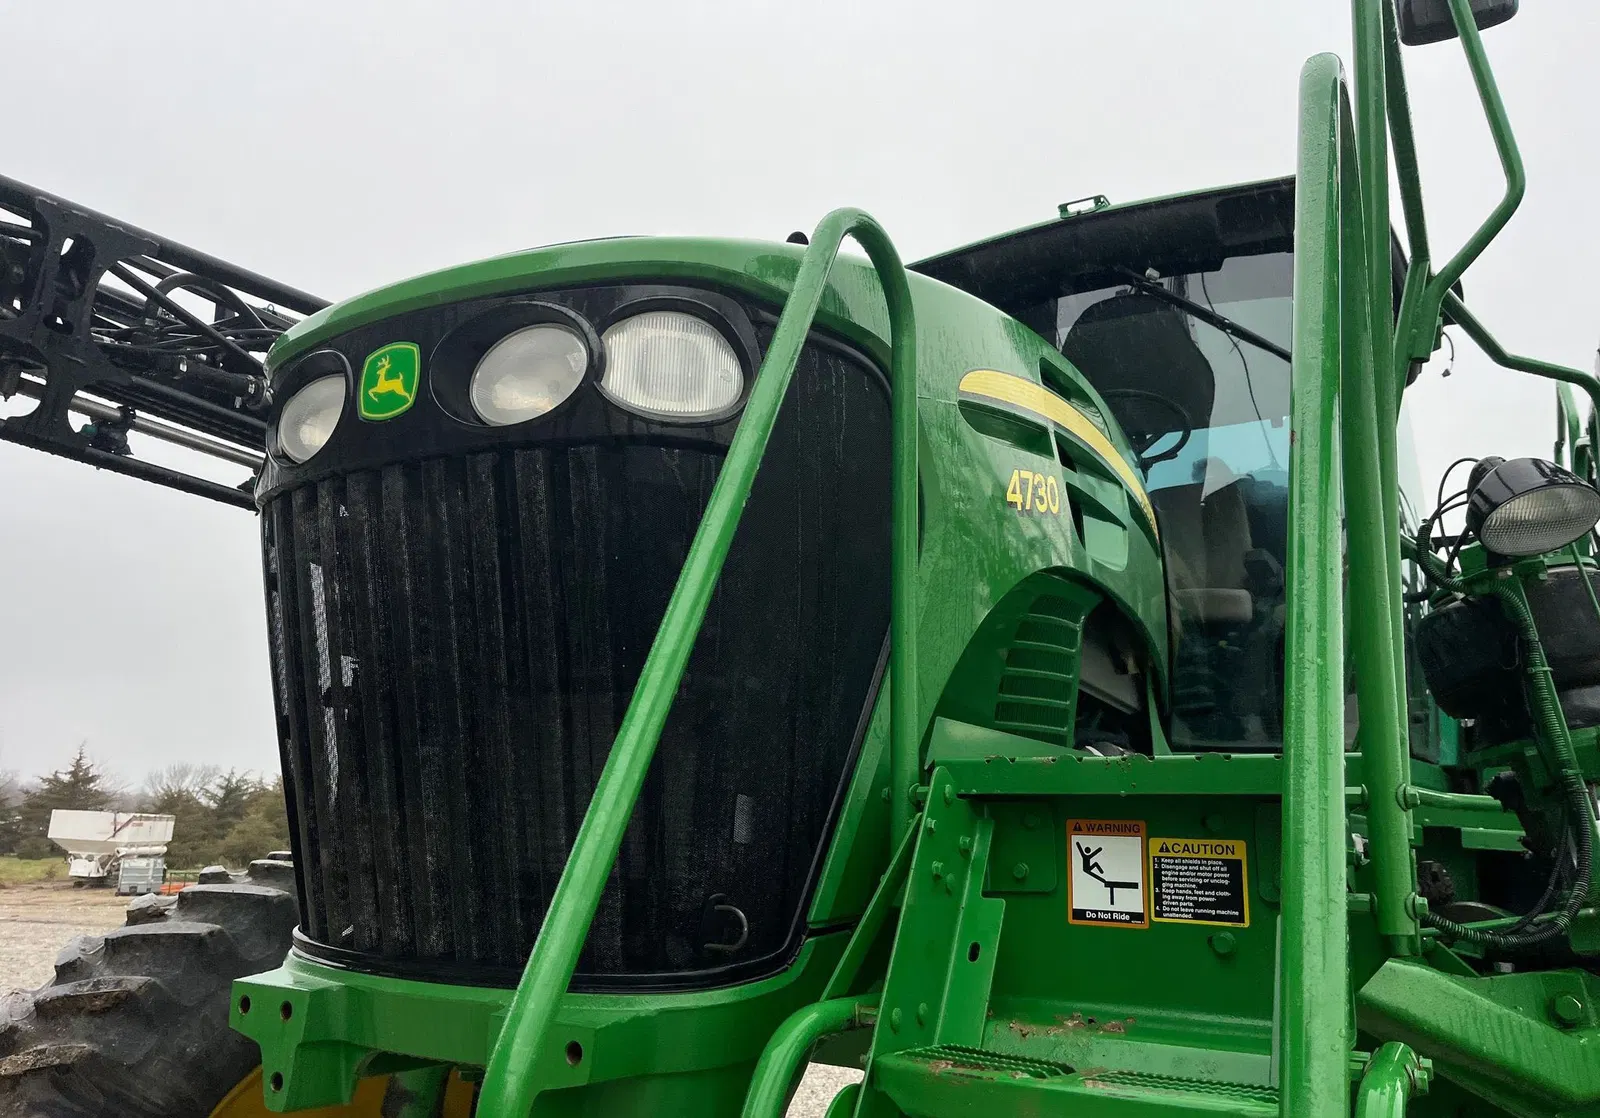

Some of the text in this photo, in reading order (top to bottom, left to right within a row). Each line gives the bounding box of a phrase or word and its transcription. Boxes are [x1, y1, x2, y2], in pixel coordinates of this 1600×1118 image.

[1006, 469, 1059, 514] 4730
[1086, 823, 1140, 833] WARNING
[1171, 842, 1236, 856] CAUTION
[1086, 910, 1130, 920] Do Not Ride
